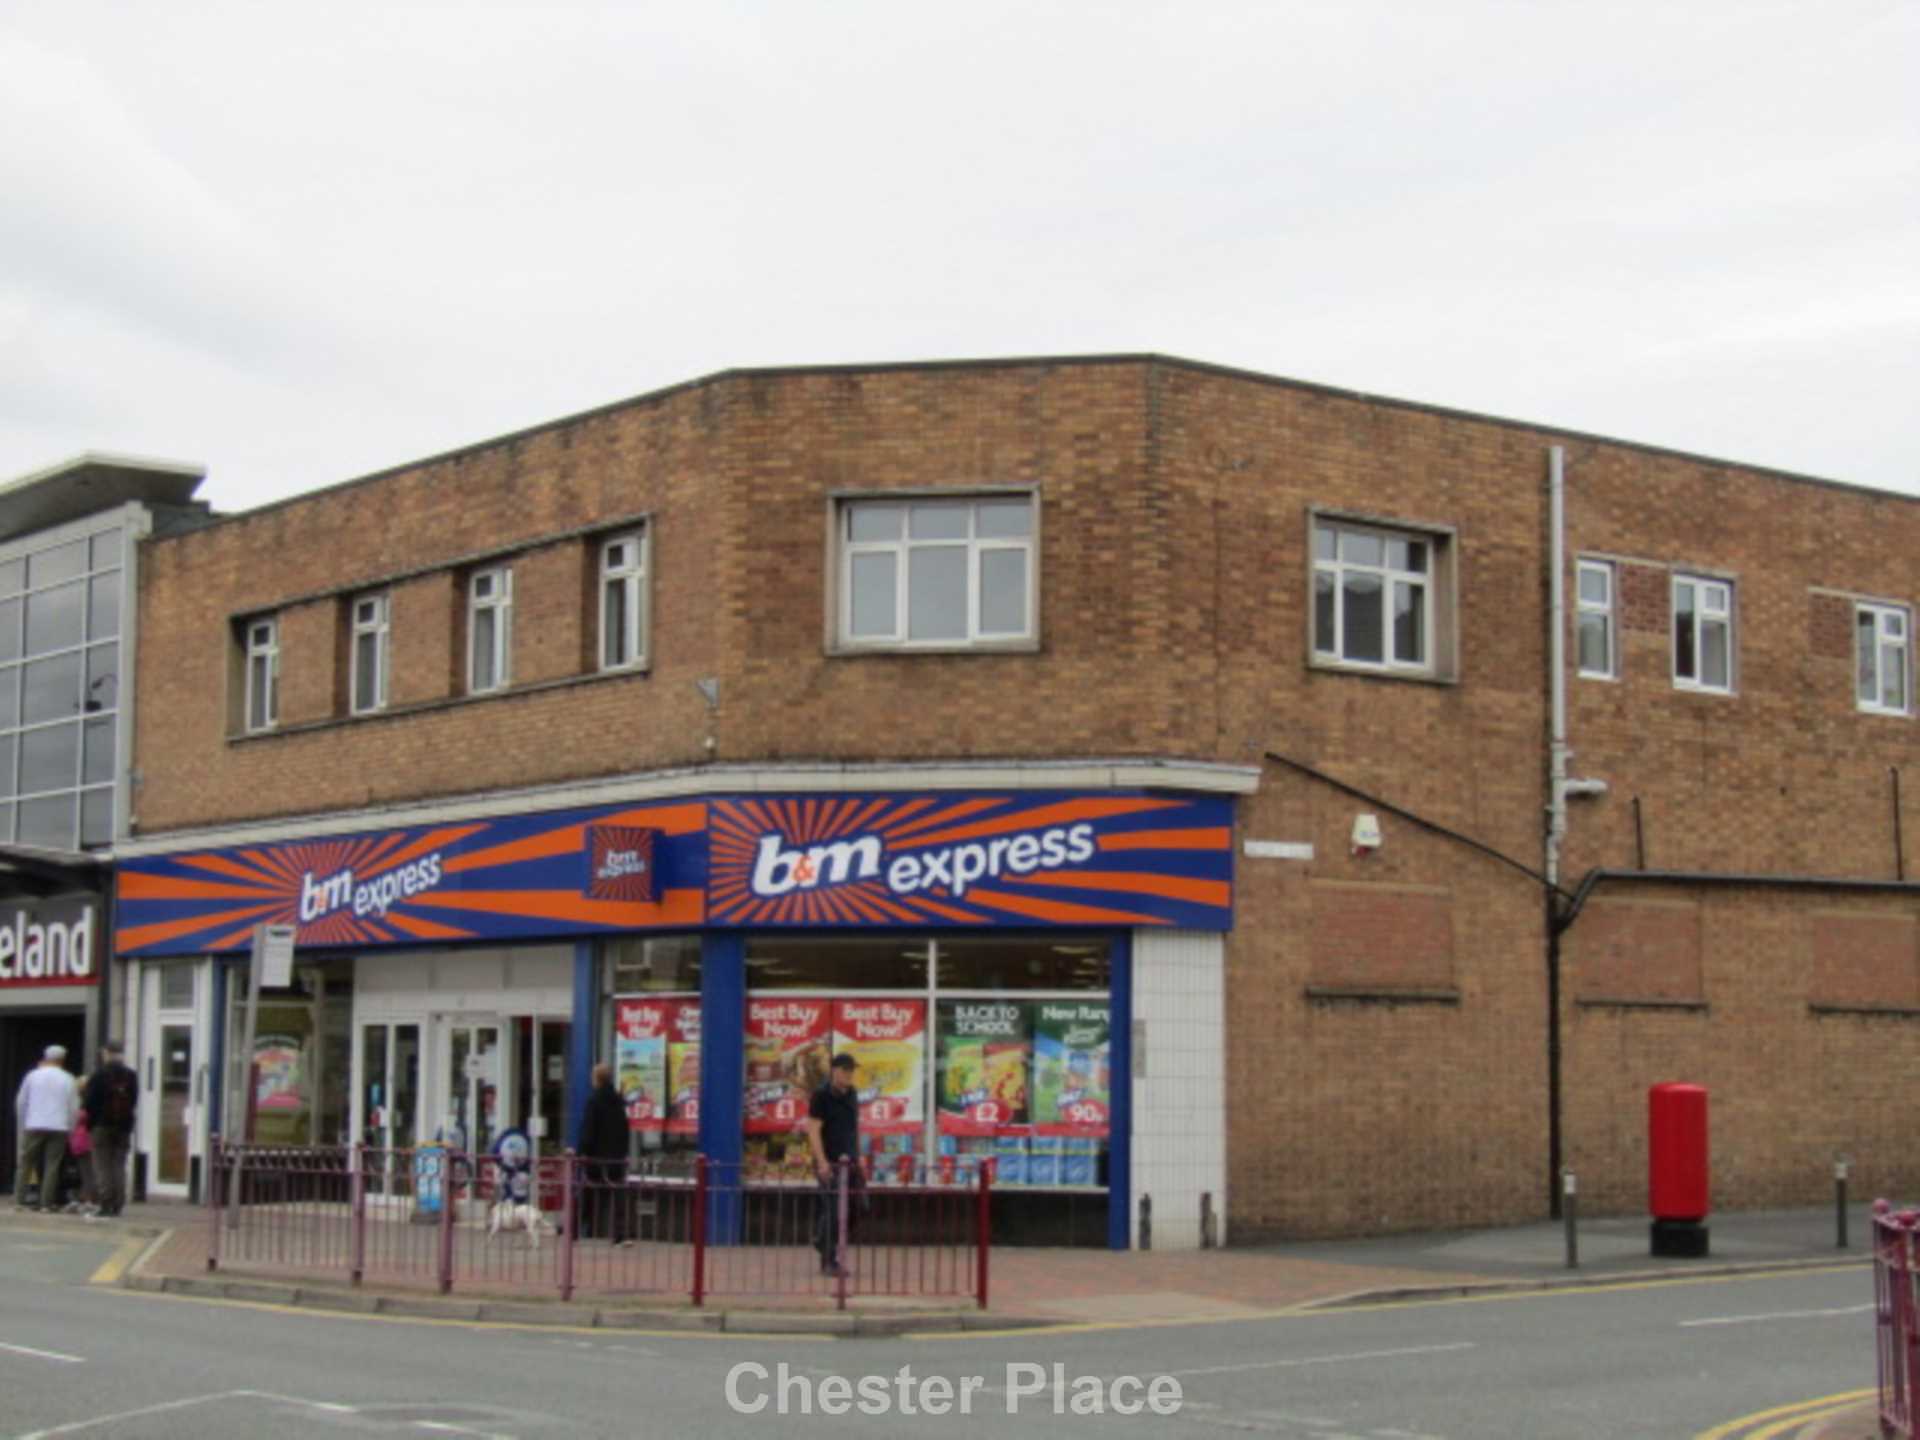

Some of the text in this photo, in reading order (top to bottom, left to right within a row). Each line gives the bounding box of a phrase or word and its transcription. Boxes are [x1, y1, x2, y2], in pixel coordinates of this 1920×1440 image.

[888, 823, 1094, 897] express
[354, 852, 442, 917] express
[1042, 1005, 1076, 1020] New
[957, 1021, 1015, 1035] SCHOOL
[976, 1103, 999, 1122] £2
